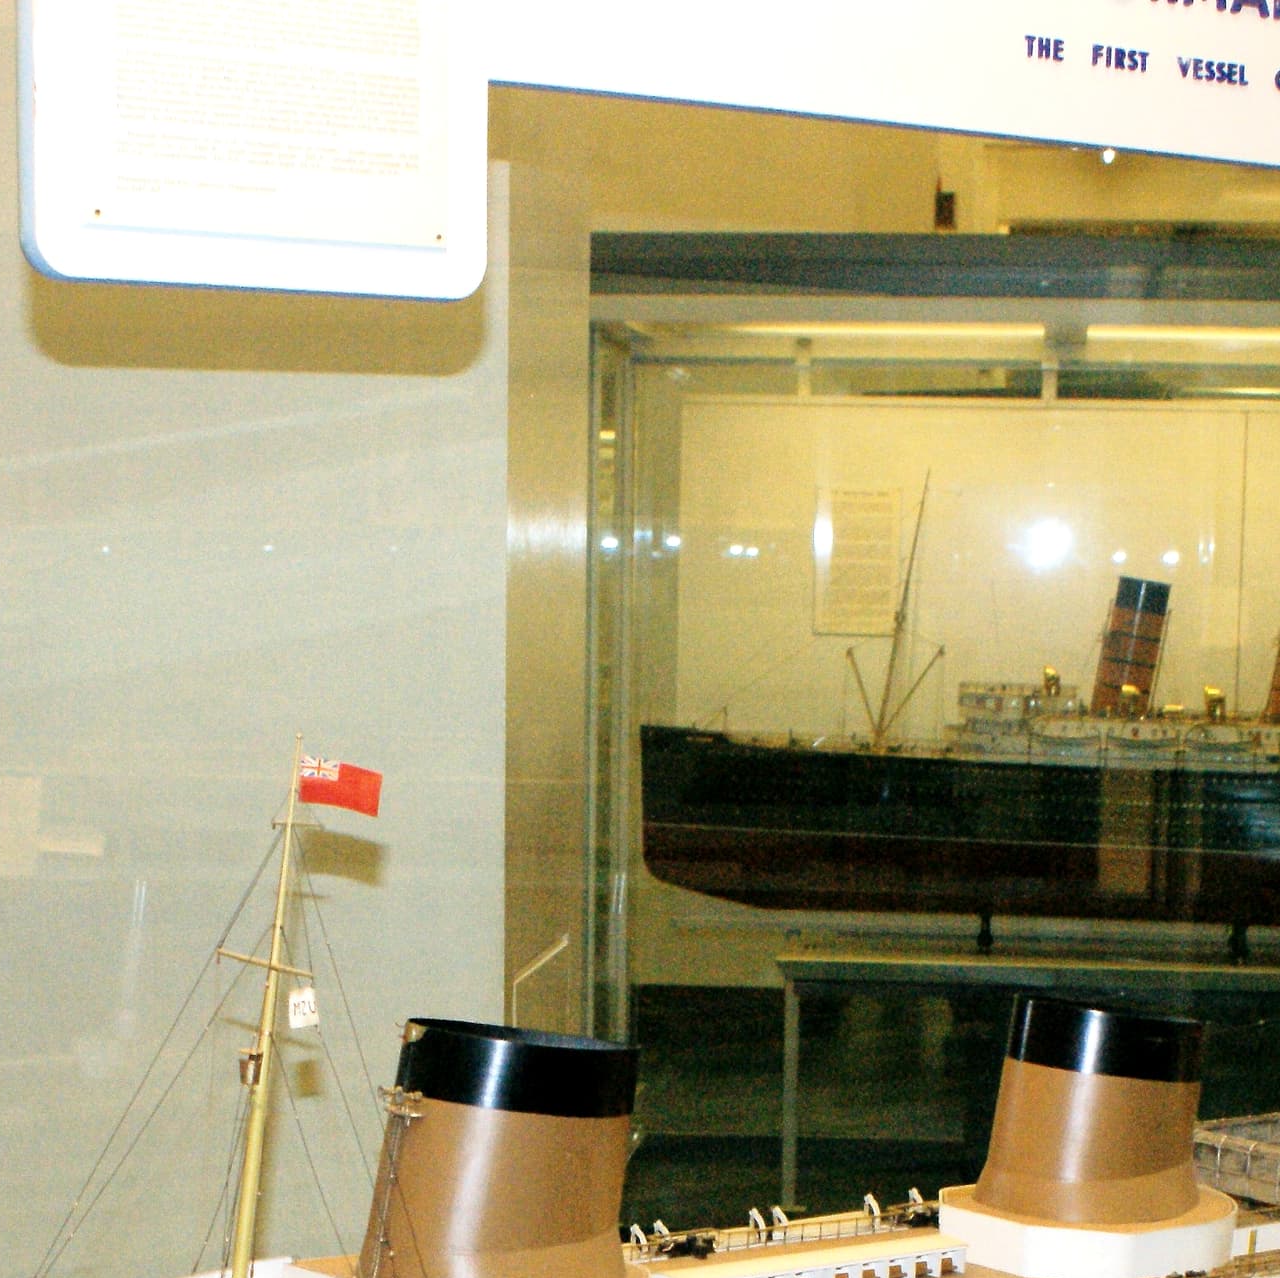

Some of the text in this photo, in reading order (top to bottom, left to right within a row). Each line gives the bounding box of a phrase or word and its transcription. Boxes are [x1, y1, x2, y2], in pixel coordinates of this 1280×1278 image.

[1024, 34, 1065, 62] THE
[1091, 43, 1150, 73] FIRST
[1177, 56, 1249, 86] VESSEL
